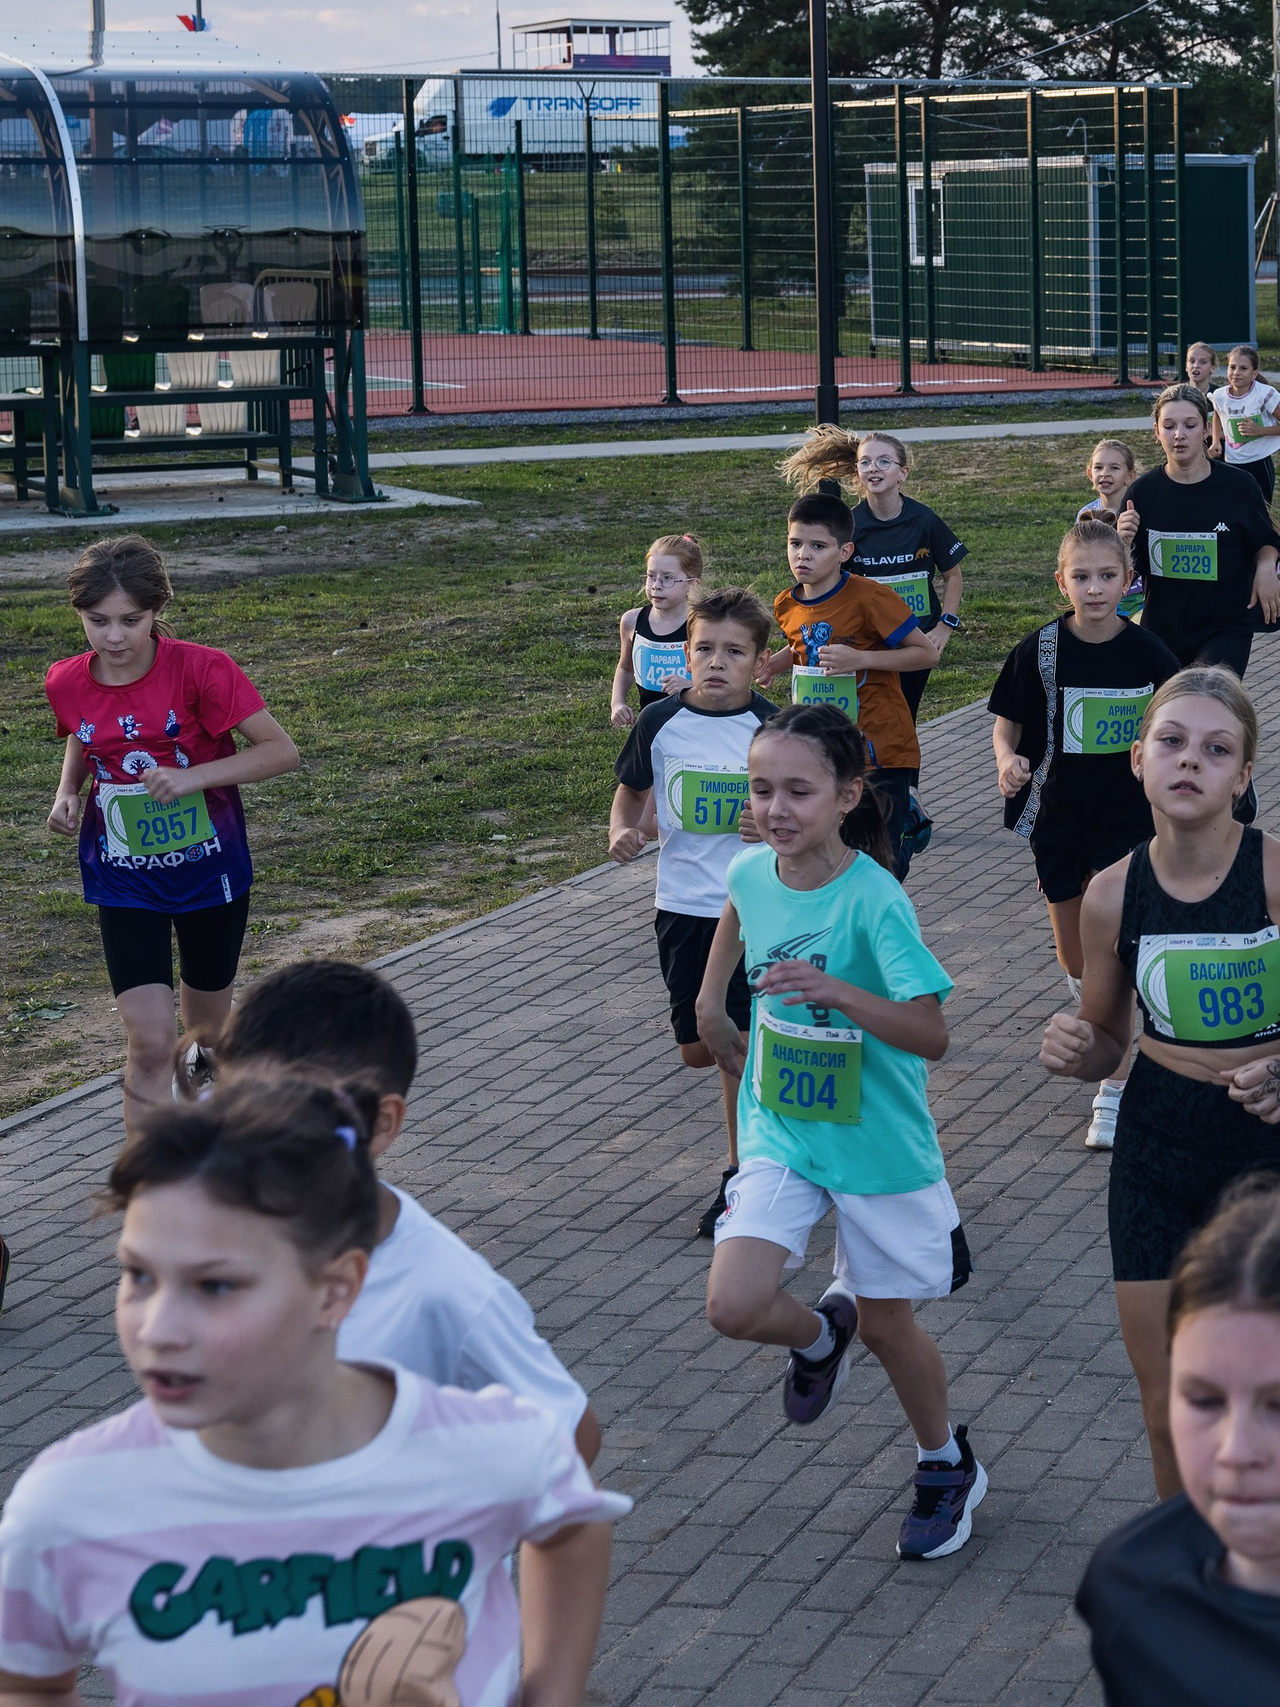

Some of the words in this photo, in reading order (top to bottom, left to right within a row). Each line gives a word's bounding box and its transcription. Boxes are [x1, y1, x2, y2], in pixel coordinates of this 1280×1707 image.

[522, 97, 642, 111] TRANSOFF
[1175, 545, 1206, 553] ВАРВАРА
[1171, 555, 1211, 574] 2329
[650, 655, 681, 665] ВАРВАРА
[812, 682, 835, 693] ИЛЬЯ
[1108, 705, 1137, 717] АРИНА
[700, 780, 750, 794] ТИМОФЕЙ
[144, 798, 180, 814] ЕЛЕНА
[136, 807, 197, 847] 2957
[1190, 958, 1266, 981] ВАСИЛИСА
[1198, 982, 1265, 1028] 983
[772, 1043, 846, 1068] АНАСТАСИЯ
[778, 1067, 837, 1110] 204
[129, 1540, 474, 1642] GARFIELD
